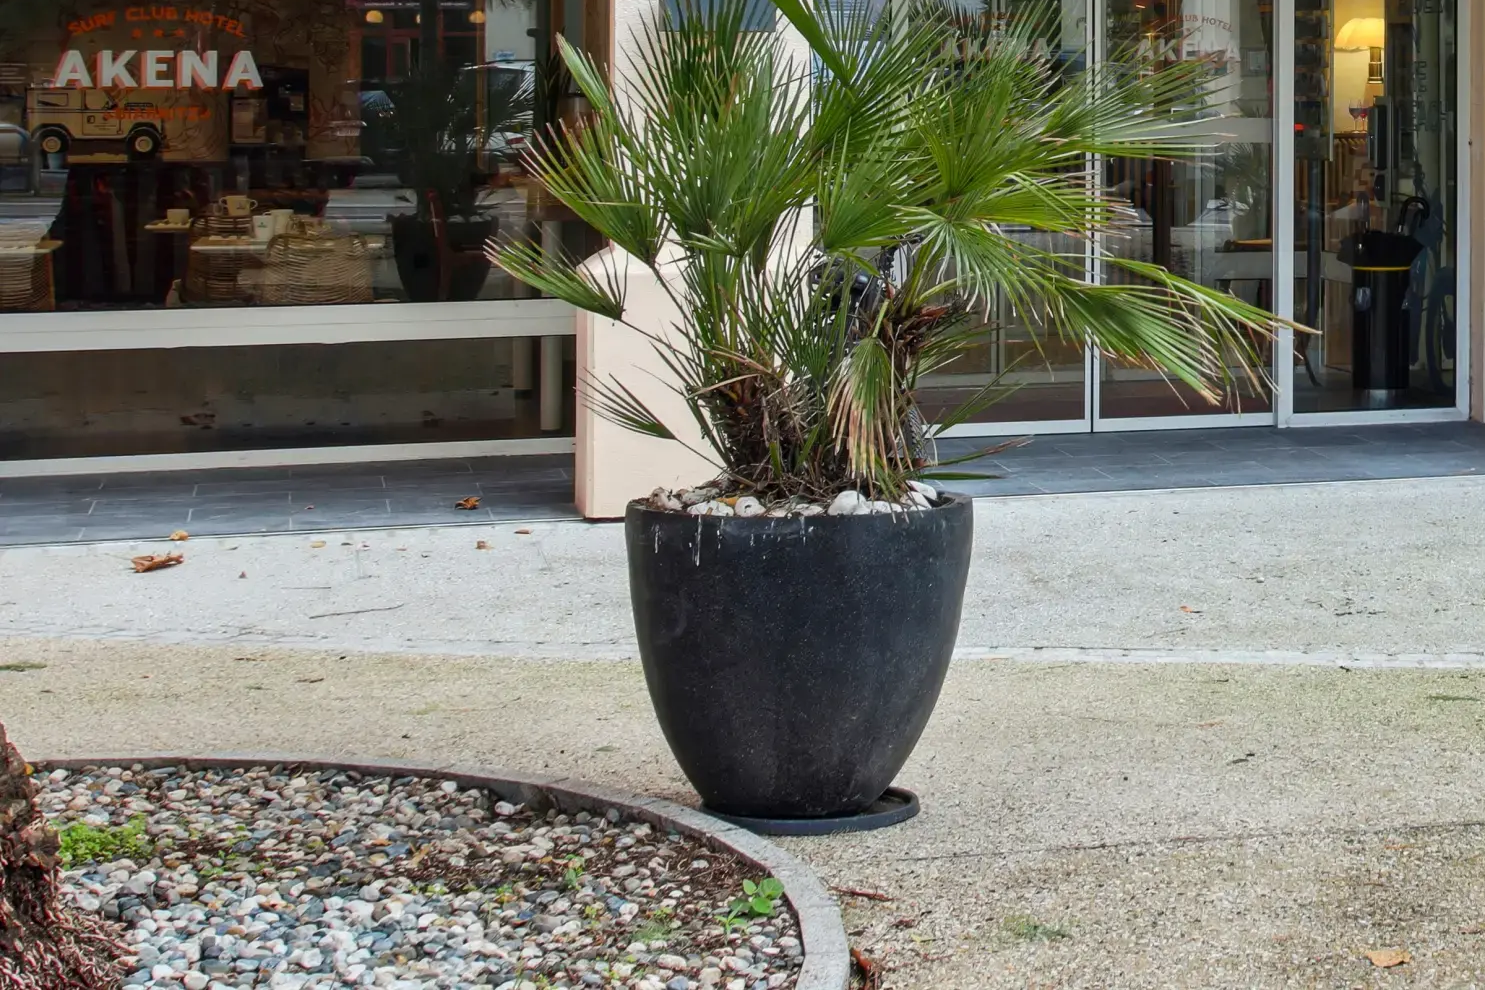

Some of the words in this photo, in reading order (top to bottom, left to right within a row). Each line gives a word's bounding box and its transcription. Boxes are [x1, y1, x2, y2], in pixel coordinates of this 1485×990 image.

[68, 11, 117, 37] SURF
[124, 6, 178, 22] CLUB
[1201, 16, 1234, 32] HOTEL
[50, 49, 264, 90] AKENA
